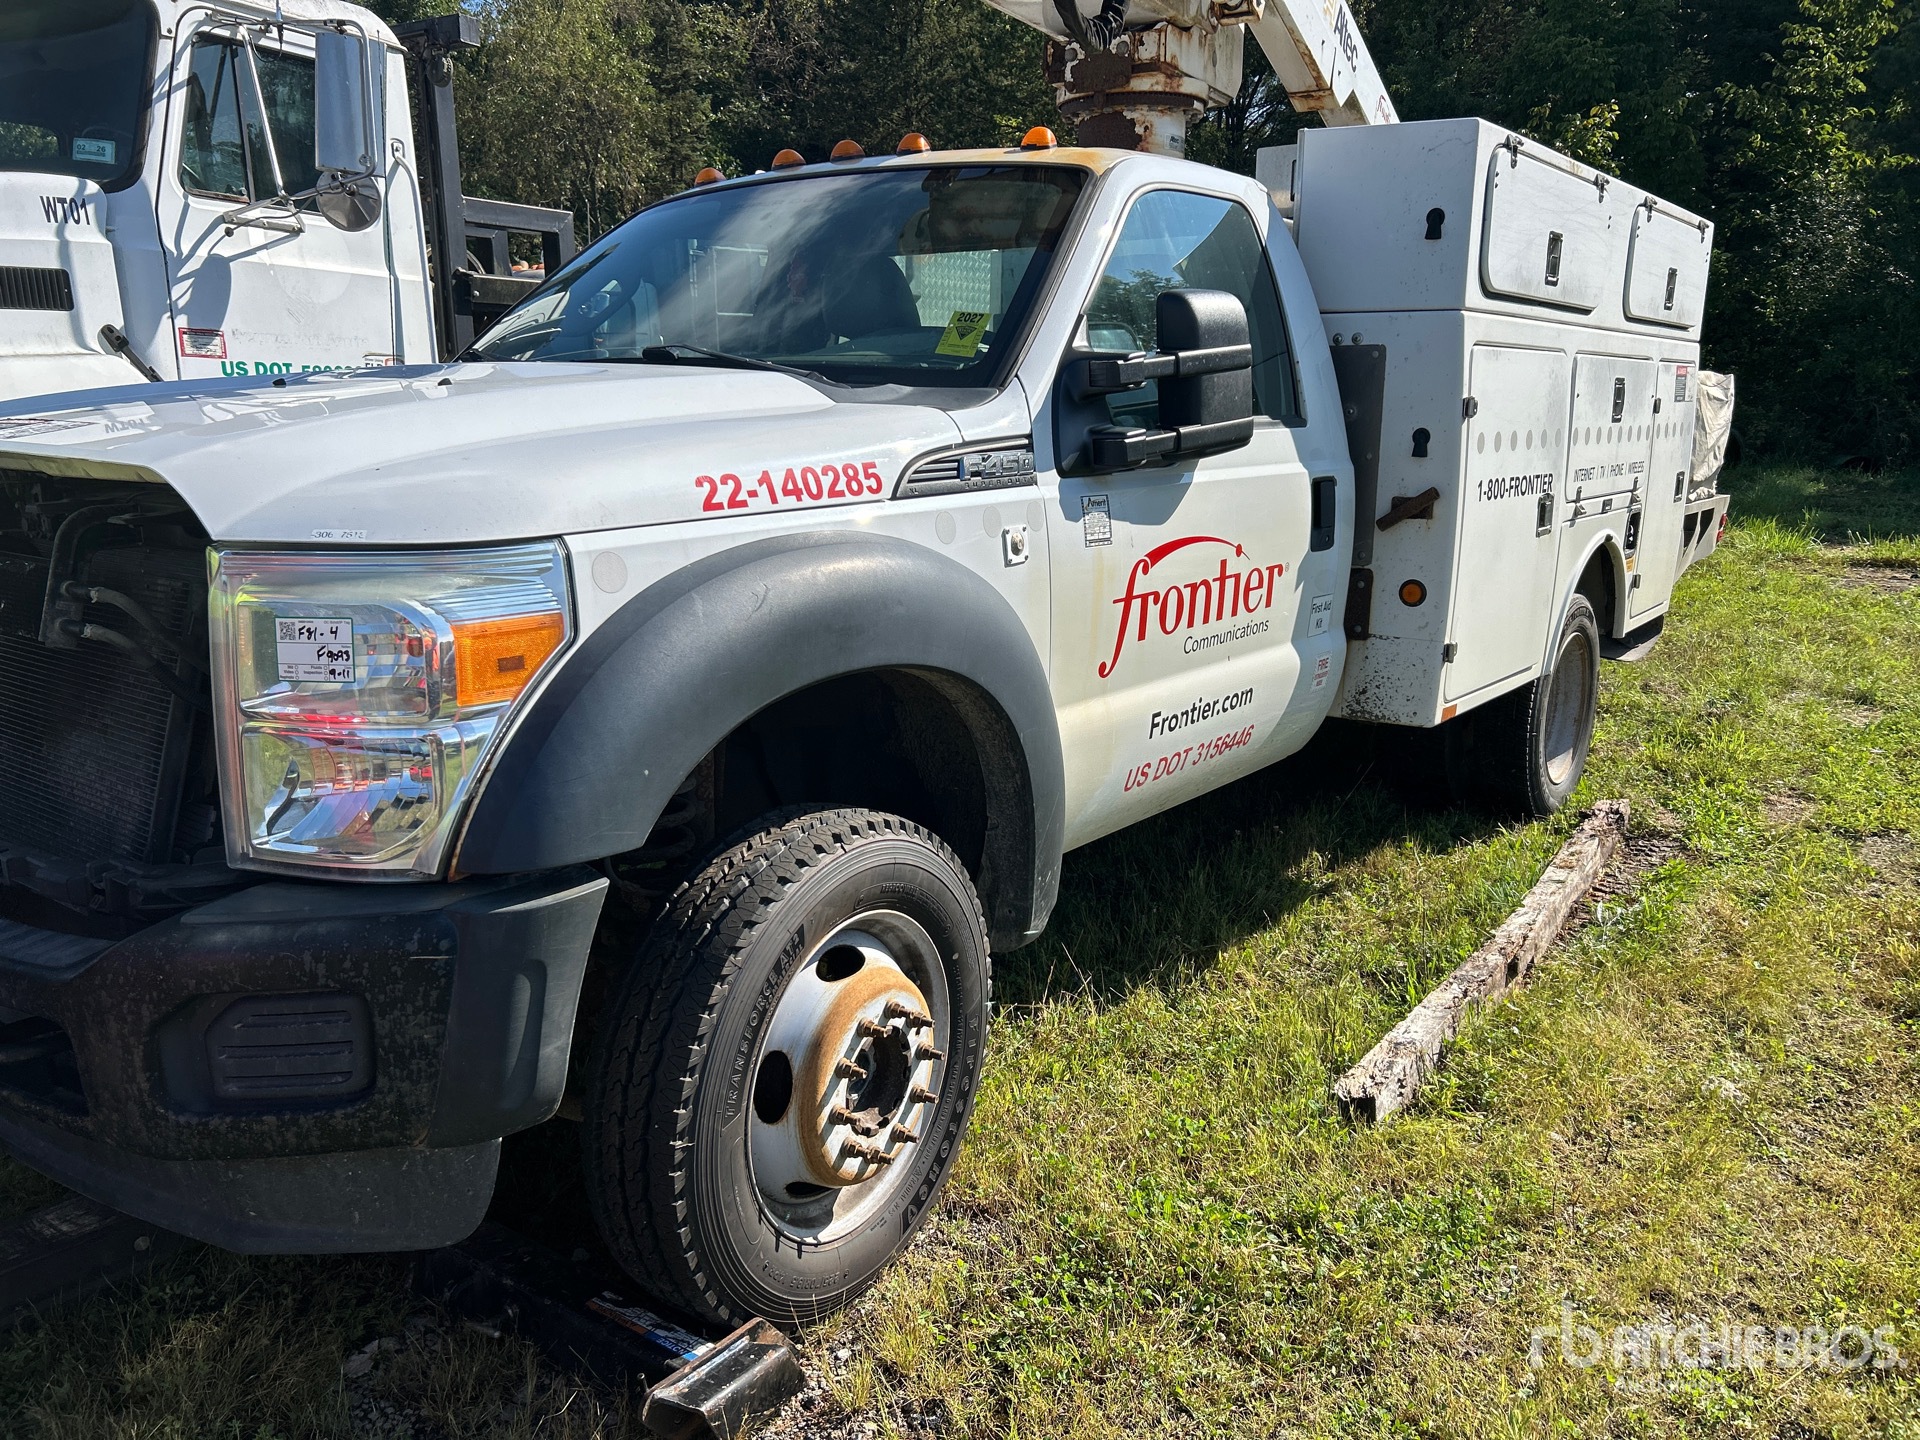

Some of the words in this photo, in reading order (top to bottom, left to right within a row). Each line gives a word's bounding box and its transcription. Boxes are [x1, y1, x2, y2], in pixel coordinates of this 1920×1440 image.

[1334, 4, 1358, 73] Altec
[96, 145, 106, 153] 26
[40, 196, 91, 226] WT01
[956, 312, 985, 323] 2027
[221, 361, 249, 377] US
[254, 361, 293, 376] DOT
[964, 480, 1002, 491] SUPER
[1007, 476, 1035, 485] DUTY
[1573, 467, 1596, 482] INTERNET
[1600, 465, 1607, 479] TV
[1610, 463, 1625, 477] PHONE
[1628, 460, 1645, 474] WIRELESS
[695, 461, 884, 513] 22-140285
[1477, 473, 1554, 502] 1-800-FRONTIER
[1098, 536, 1284, 679] frontier
[1312, 603, 1323, 615] First
[1323, 600, 1332, 612] Aid
[1183, 619, 1269, 655] Communications
[1315, 617, 1323, 630] Kit
[1149, 686, 1254, 740] Frontier.com
[1124, 765, 1149, 793] US
[1152, 747, 1194, 783] DOT
[1196, 724, 1255, 767] 3156446
[724, 969, 778, 1120] TRANSFORCE
[778, 930, 800, 970] AT2
